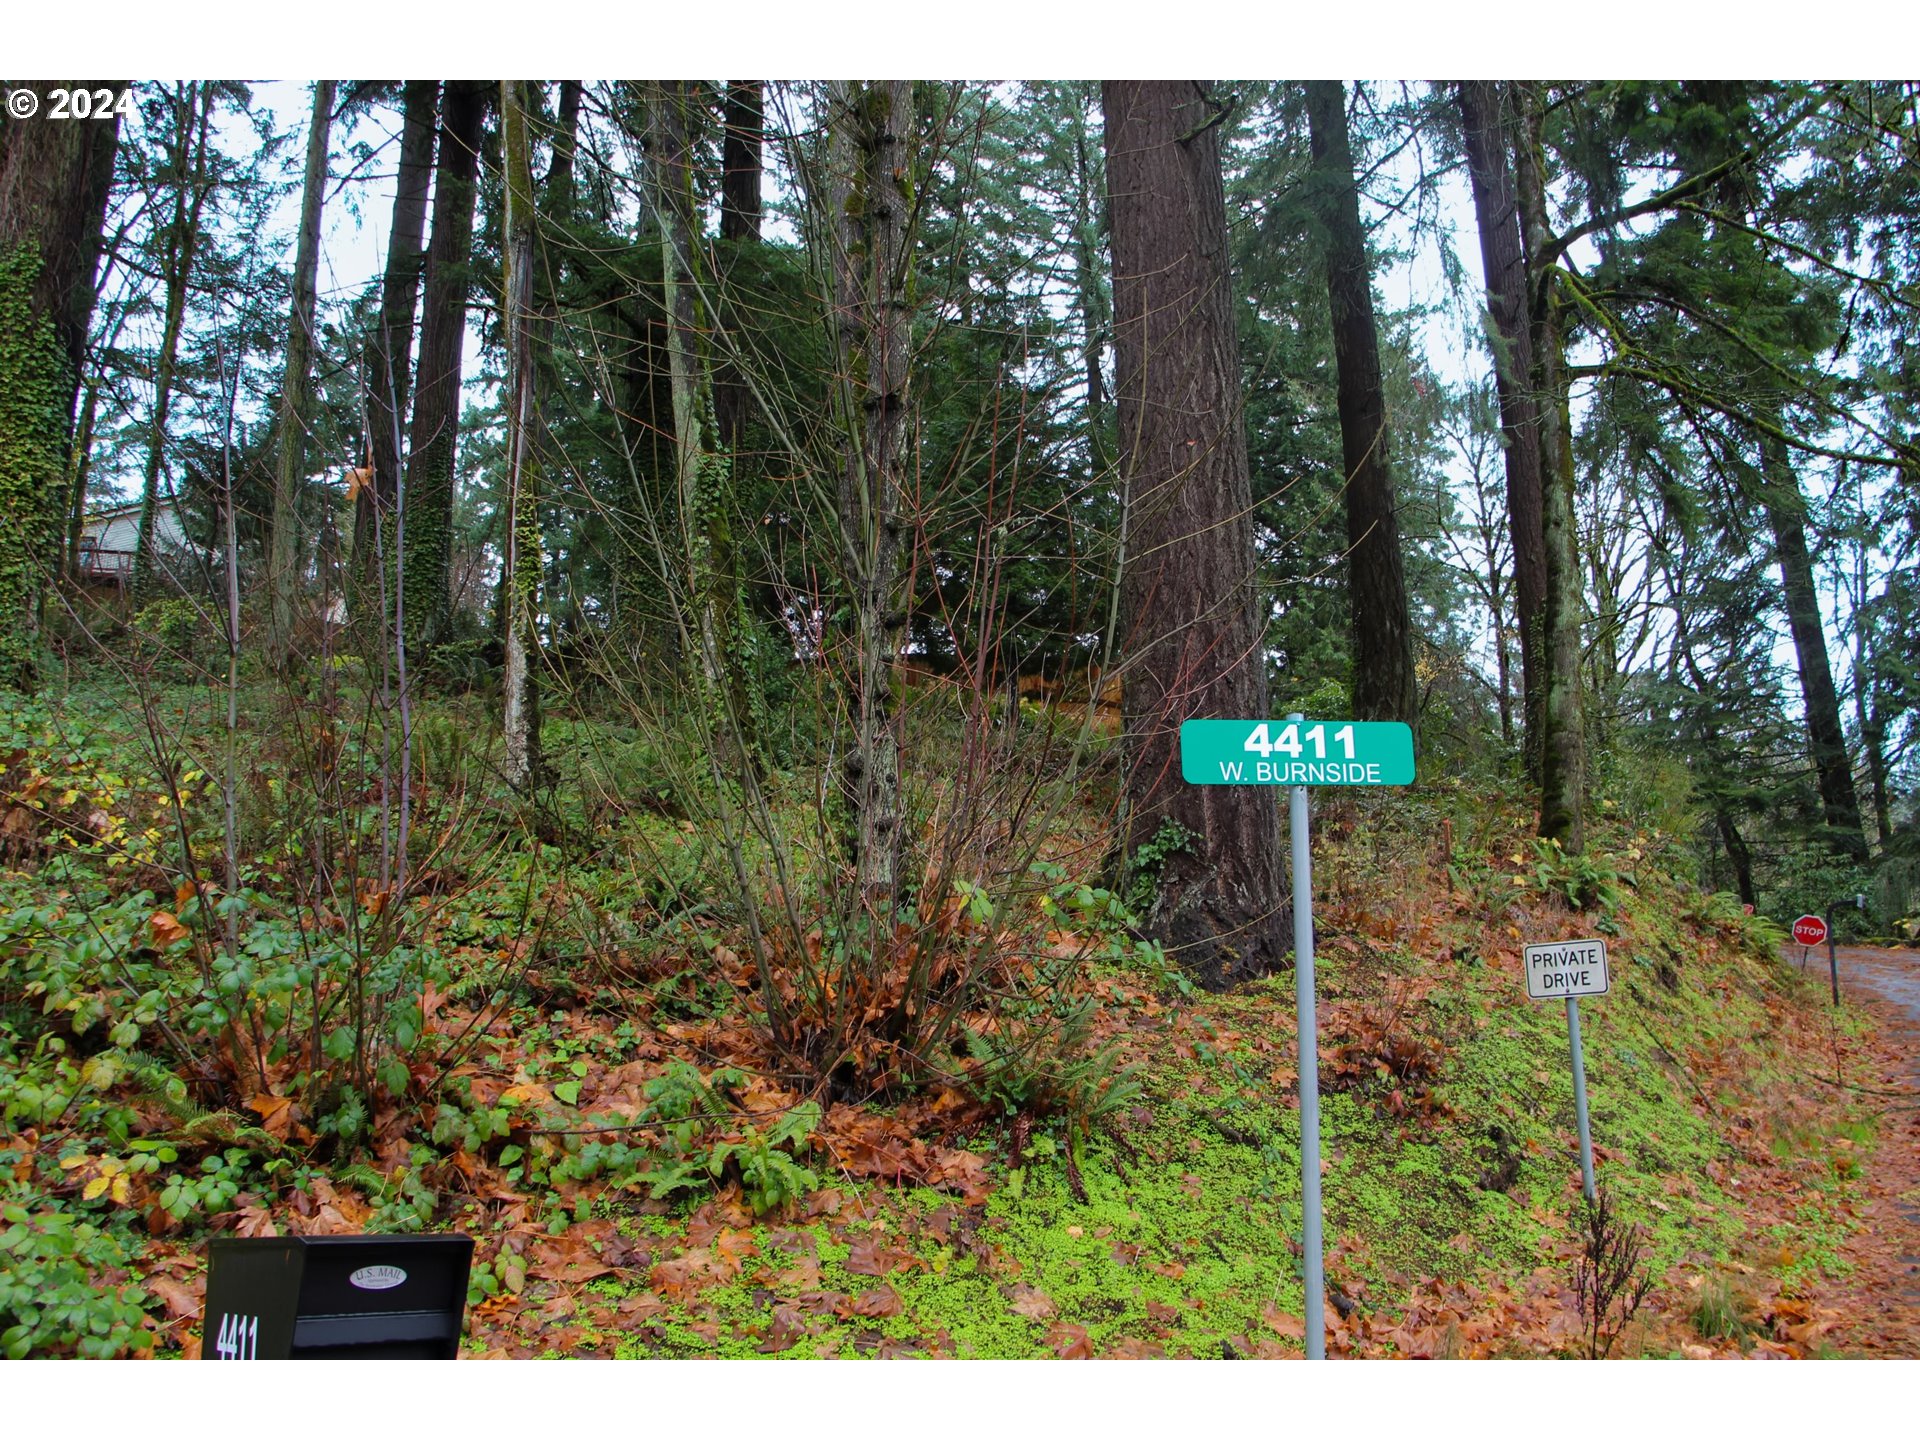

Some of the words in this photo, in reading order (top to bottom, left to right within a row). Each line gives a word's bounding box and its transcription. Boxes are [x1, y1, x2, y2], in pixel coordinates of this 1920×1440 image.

[1244, 723, 1355, 759] 4411
[1219, 762, 1249, 782] W.
[1257, 762, 1382, 783] BURNSIDE
[1795, 925, 1824, 937] STOP
[1532, 949, 1598, 969] PRIVATE
[1543, 971, 1591, 989] DRIVE
[356, 1268, 376, 1281] U.S.
[378, 1267, 402, 1280] MAIL
[217, 1312, 258, 1360] 4411
